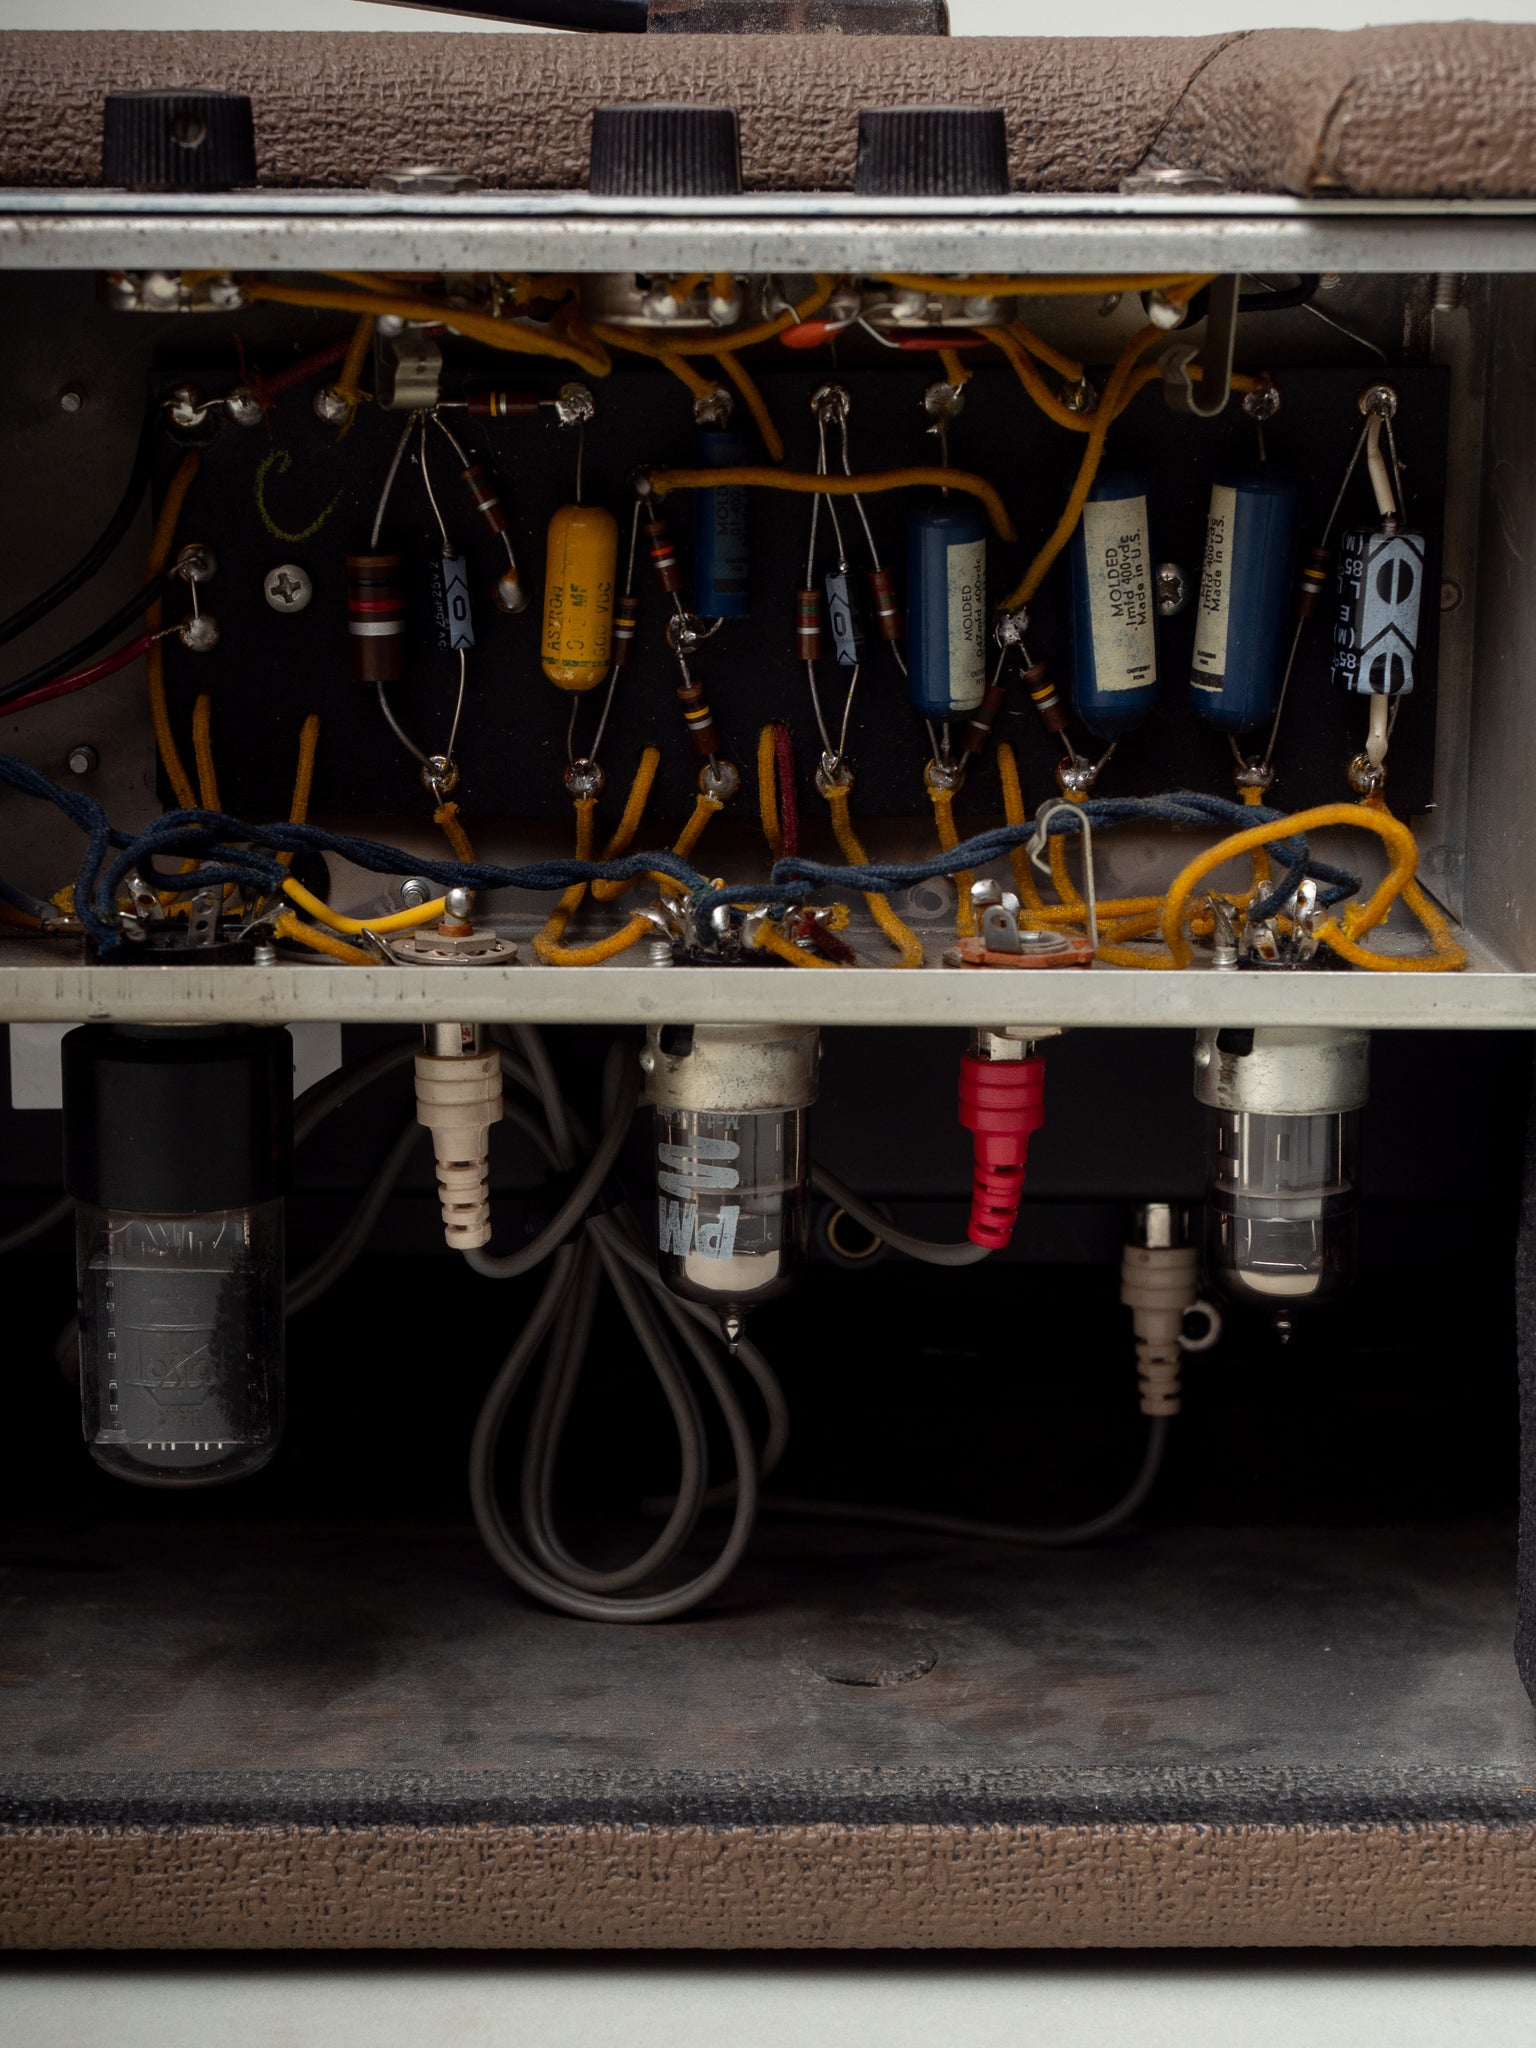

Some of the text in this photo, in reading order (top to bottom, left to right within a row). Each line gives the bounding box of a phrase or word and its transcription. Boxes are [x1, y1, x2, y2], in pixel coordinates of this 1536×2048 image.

[1119, 534, 1133, 585] 400vdc
[1132, 564, 1144, 578] in
[1213, 550, 1223, 564] in
[1105, 547, 1124, 617] MOLDED
[1133, 582, 1147, 625] Made
[1211, 569, 1223, 612] Made
[961, 585, 973, 641] MOLDED
